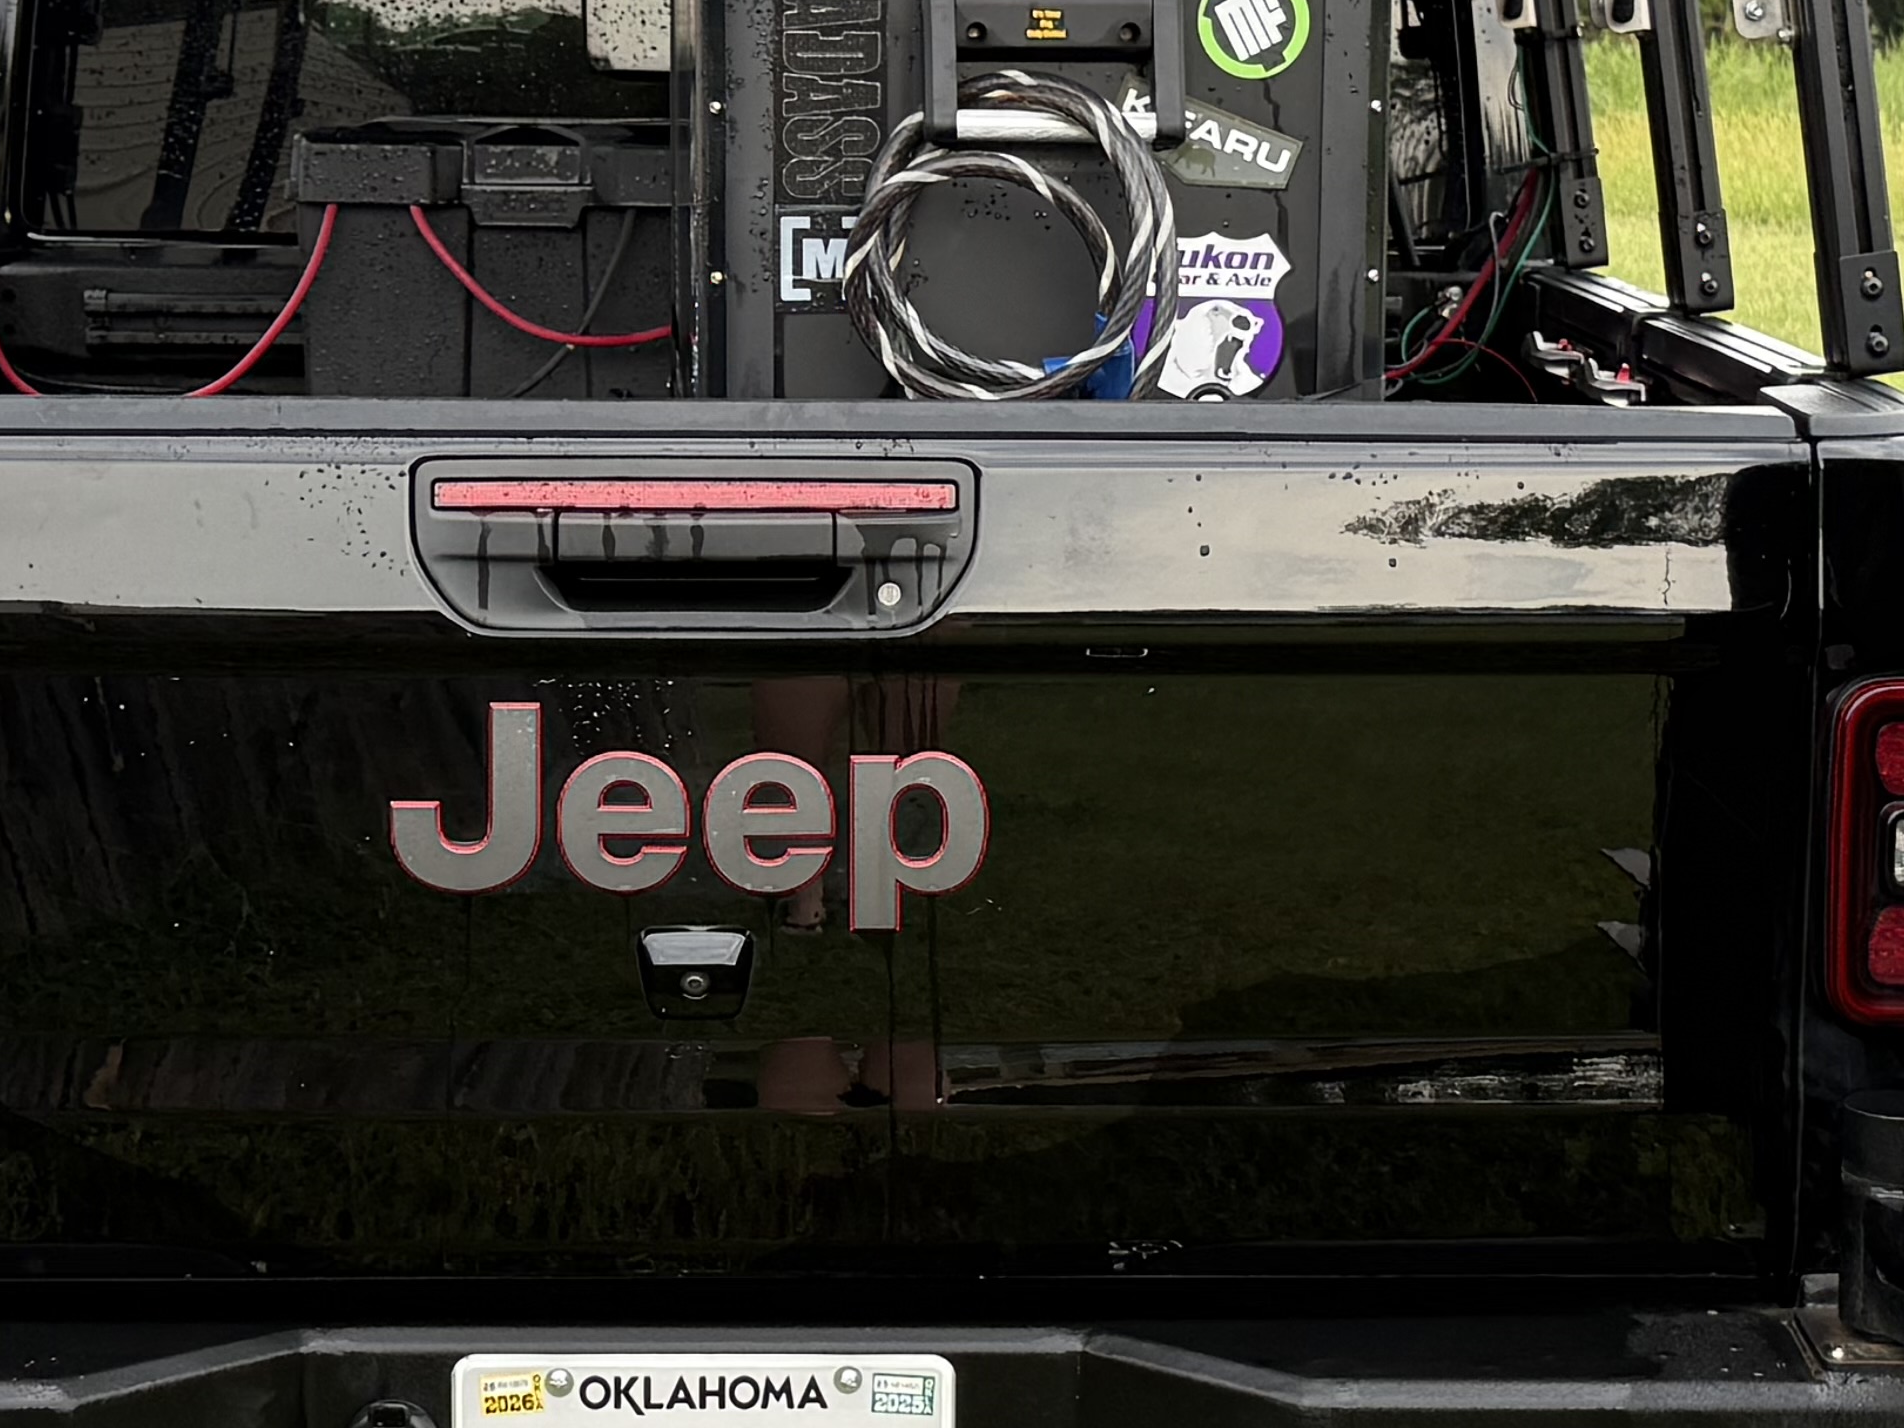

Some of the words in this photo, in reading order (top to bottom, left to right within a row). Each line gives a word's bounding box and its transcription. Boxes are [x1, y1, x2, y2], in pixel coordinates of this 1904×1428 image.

[1177, 243, 1275, 270] ukon
[1206, 272, 1221, 286] &
[1225, 273, 1272, 286] Axle
[388, 700, 992, 933] Jeep
[483, 1393, 535, 1414] 2026
[578, 1375, 829, 1415] OKLAHOMA
[873, 1393, 925, 1414] 2025
